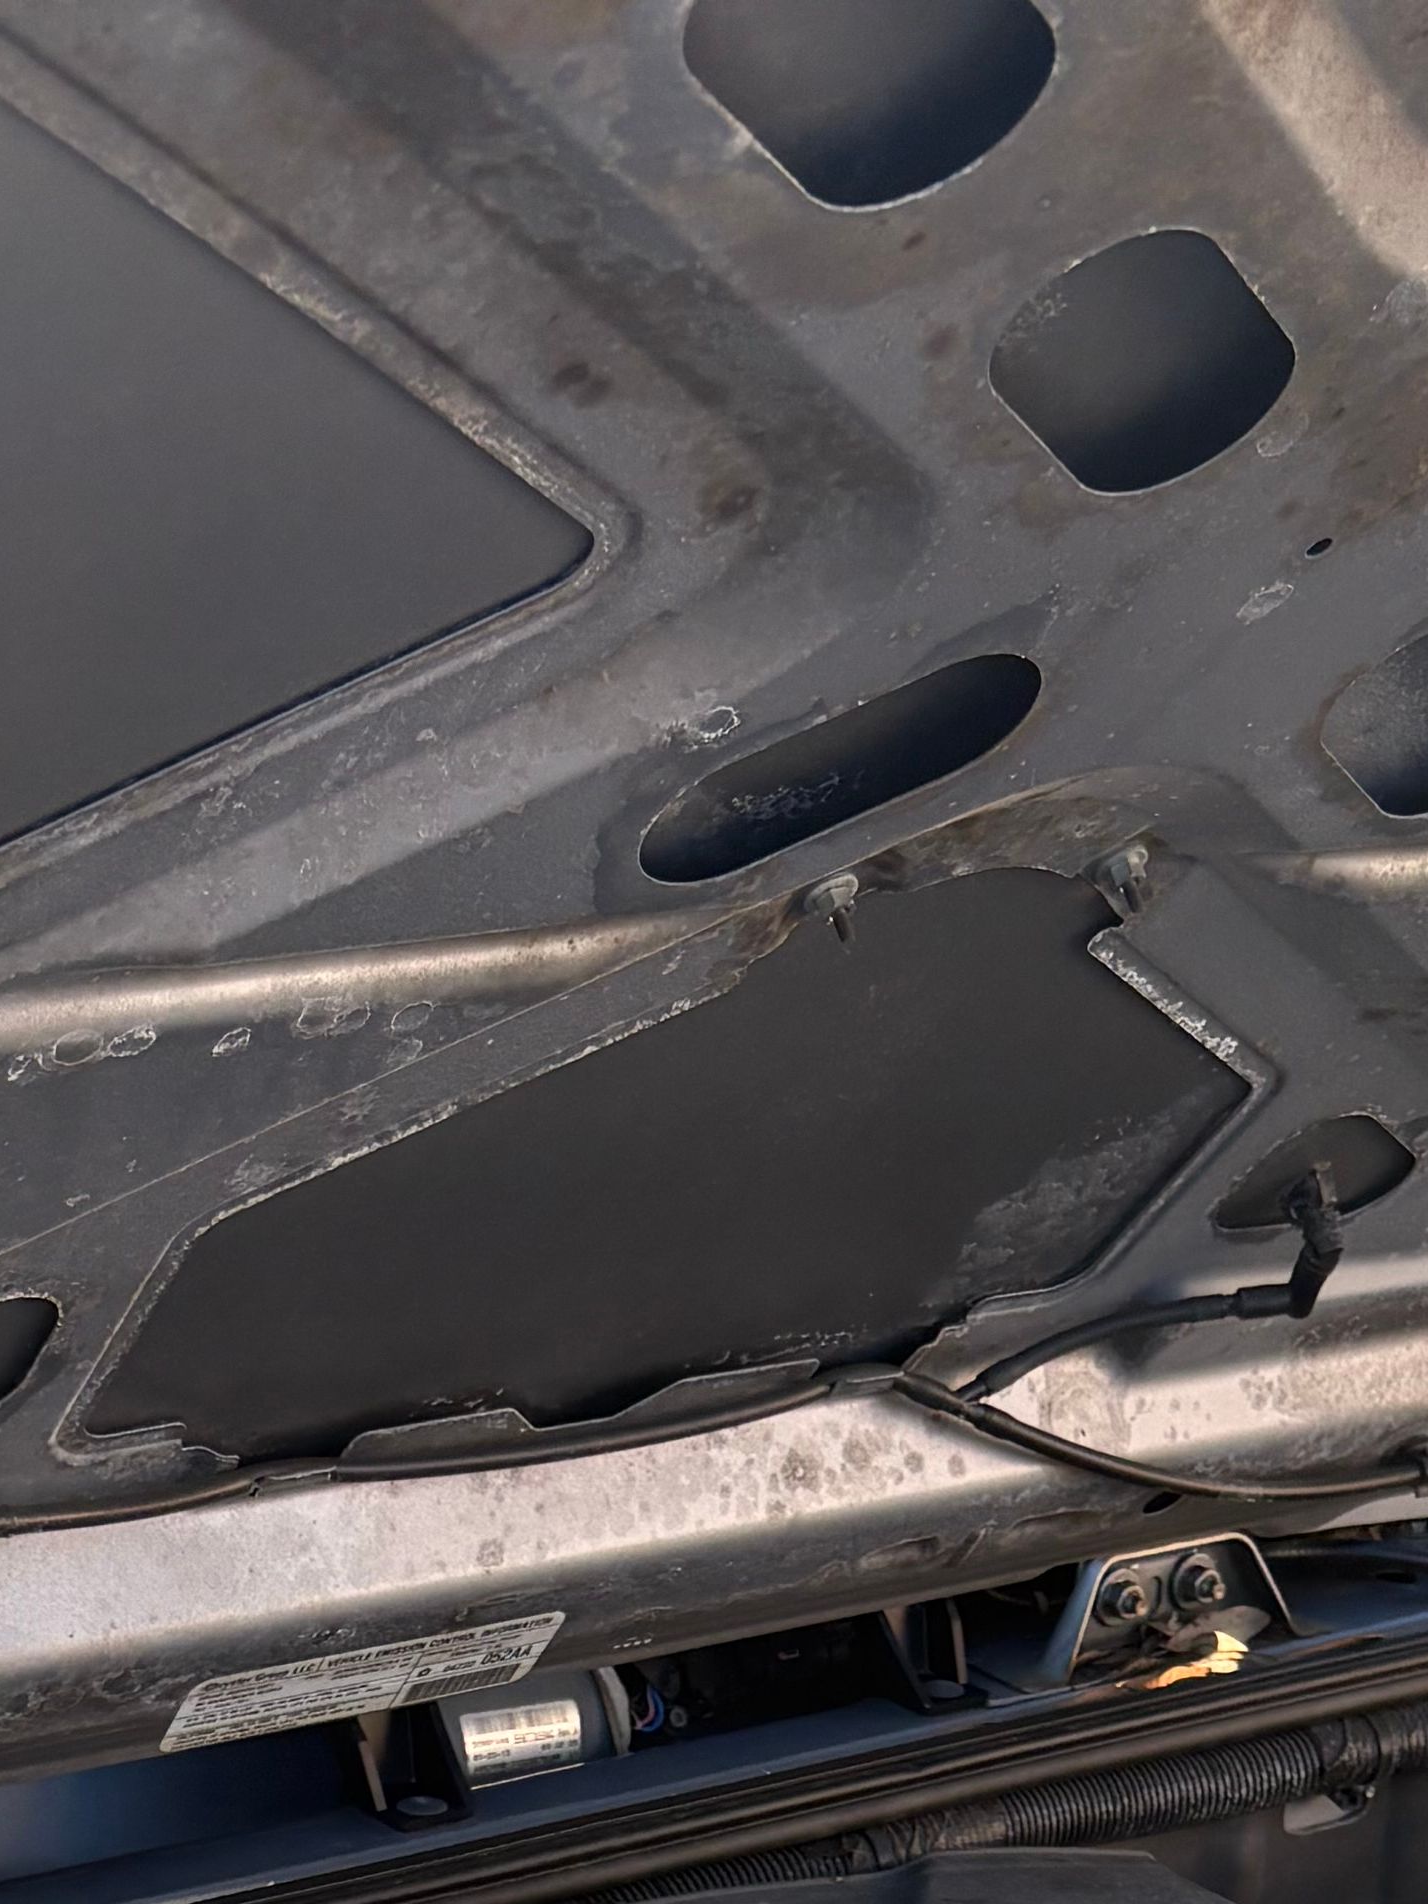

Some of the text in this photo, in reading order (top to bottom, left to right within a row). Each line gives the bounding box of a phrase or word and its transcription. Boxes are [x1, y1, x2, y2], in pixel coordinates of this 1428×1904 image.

[327, 1653, 370, 1667] VEHICLE
[375, 1642, 426, 1658] EMISSION
[429, 1632, 475, 1648] CONTROL
